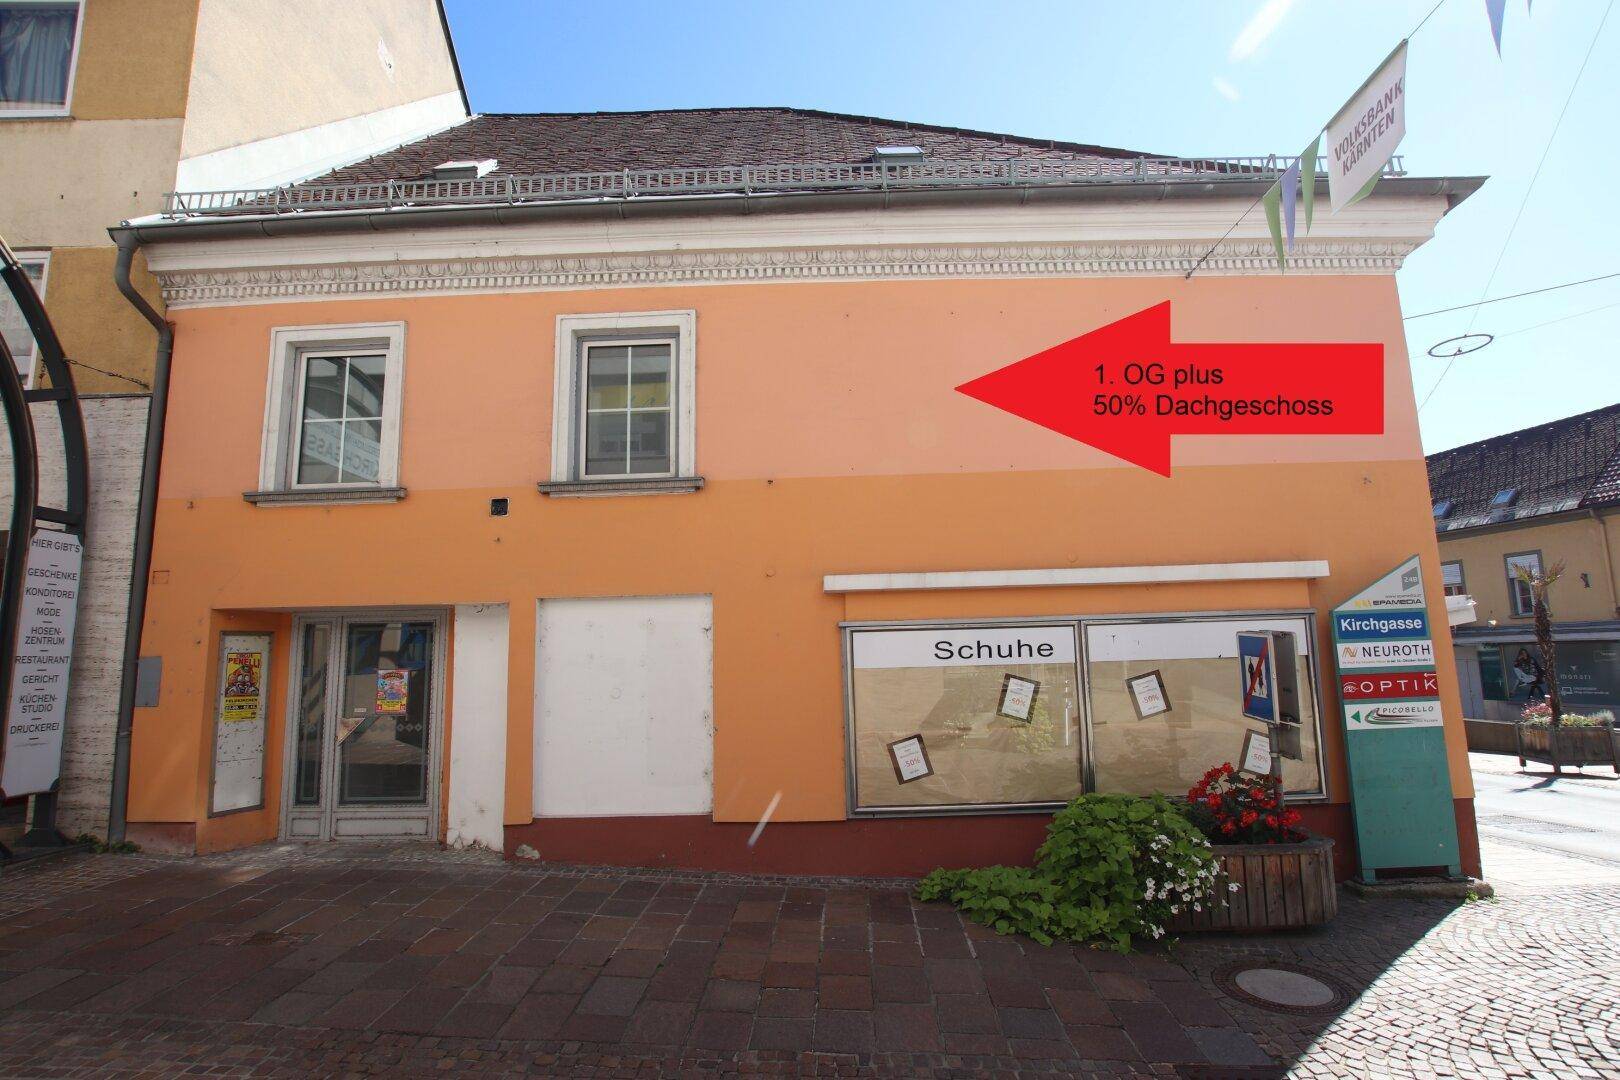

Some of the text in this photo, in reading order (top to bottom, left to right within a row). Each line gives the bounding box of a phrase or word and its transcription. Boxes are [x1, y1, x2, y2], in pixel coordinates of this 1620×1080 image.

[1334, 76, 1403, 162] VOLKSBANK
[1342, 107, 1395, 177] KÄRNTEN
[31, 538, 80, 553] HIER GIBT'S
[27, 567, 78, 581] GESCHENKE
[25, 587, 75, 599] KONDITOREI
[36, 608, 61, 617] MODE
[31, 626, 62, 636] HOSEN-
[1340, 618, 1423, 633] Kirchgasse
[25, 635, 65, 645] ZENTRUM
[934, 639, 1054, 660] Schuhe
[1362, 644, 1431, 657] NEUROTH
[15, 655, 70, 665] RESTAURANT
[228, 657, 261, 668] PENELLI
[22, 674, 60, 684] GERICHT
[1361, 678, 1438, 693] OPTIK
[19, 693, 58, 704] KÜCHEN-
[21, 704, 53, 714] STUDIO
[1382, 705, 1434, 714] PICOBELLO
[10, 722, 60, 735] DRUCKEREI
